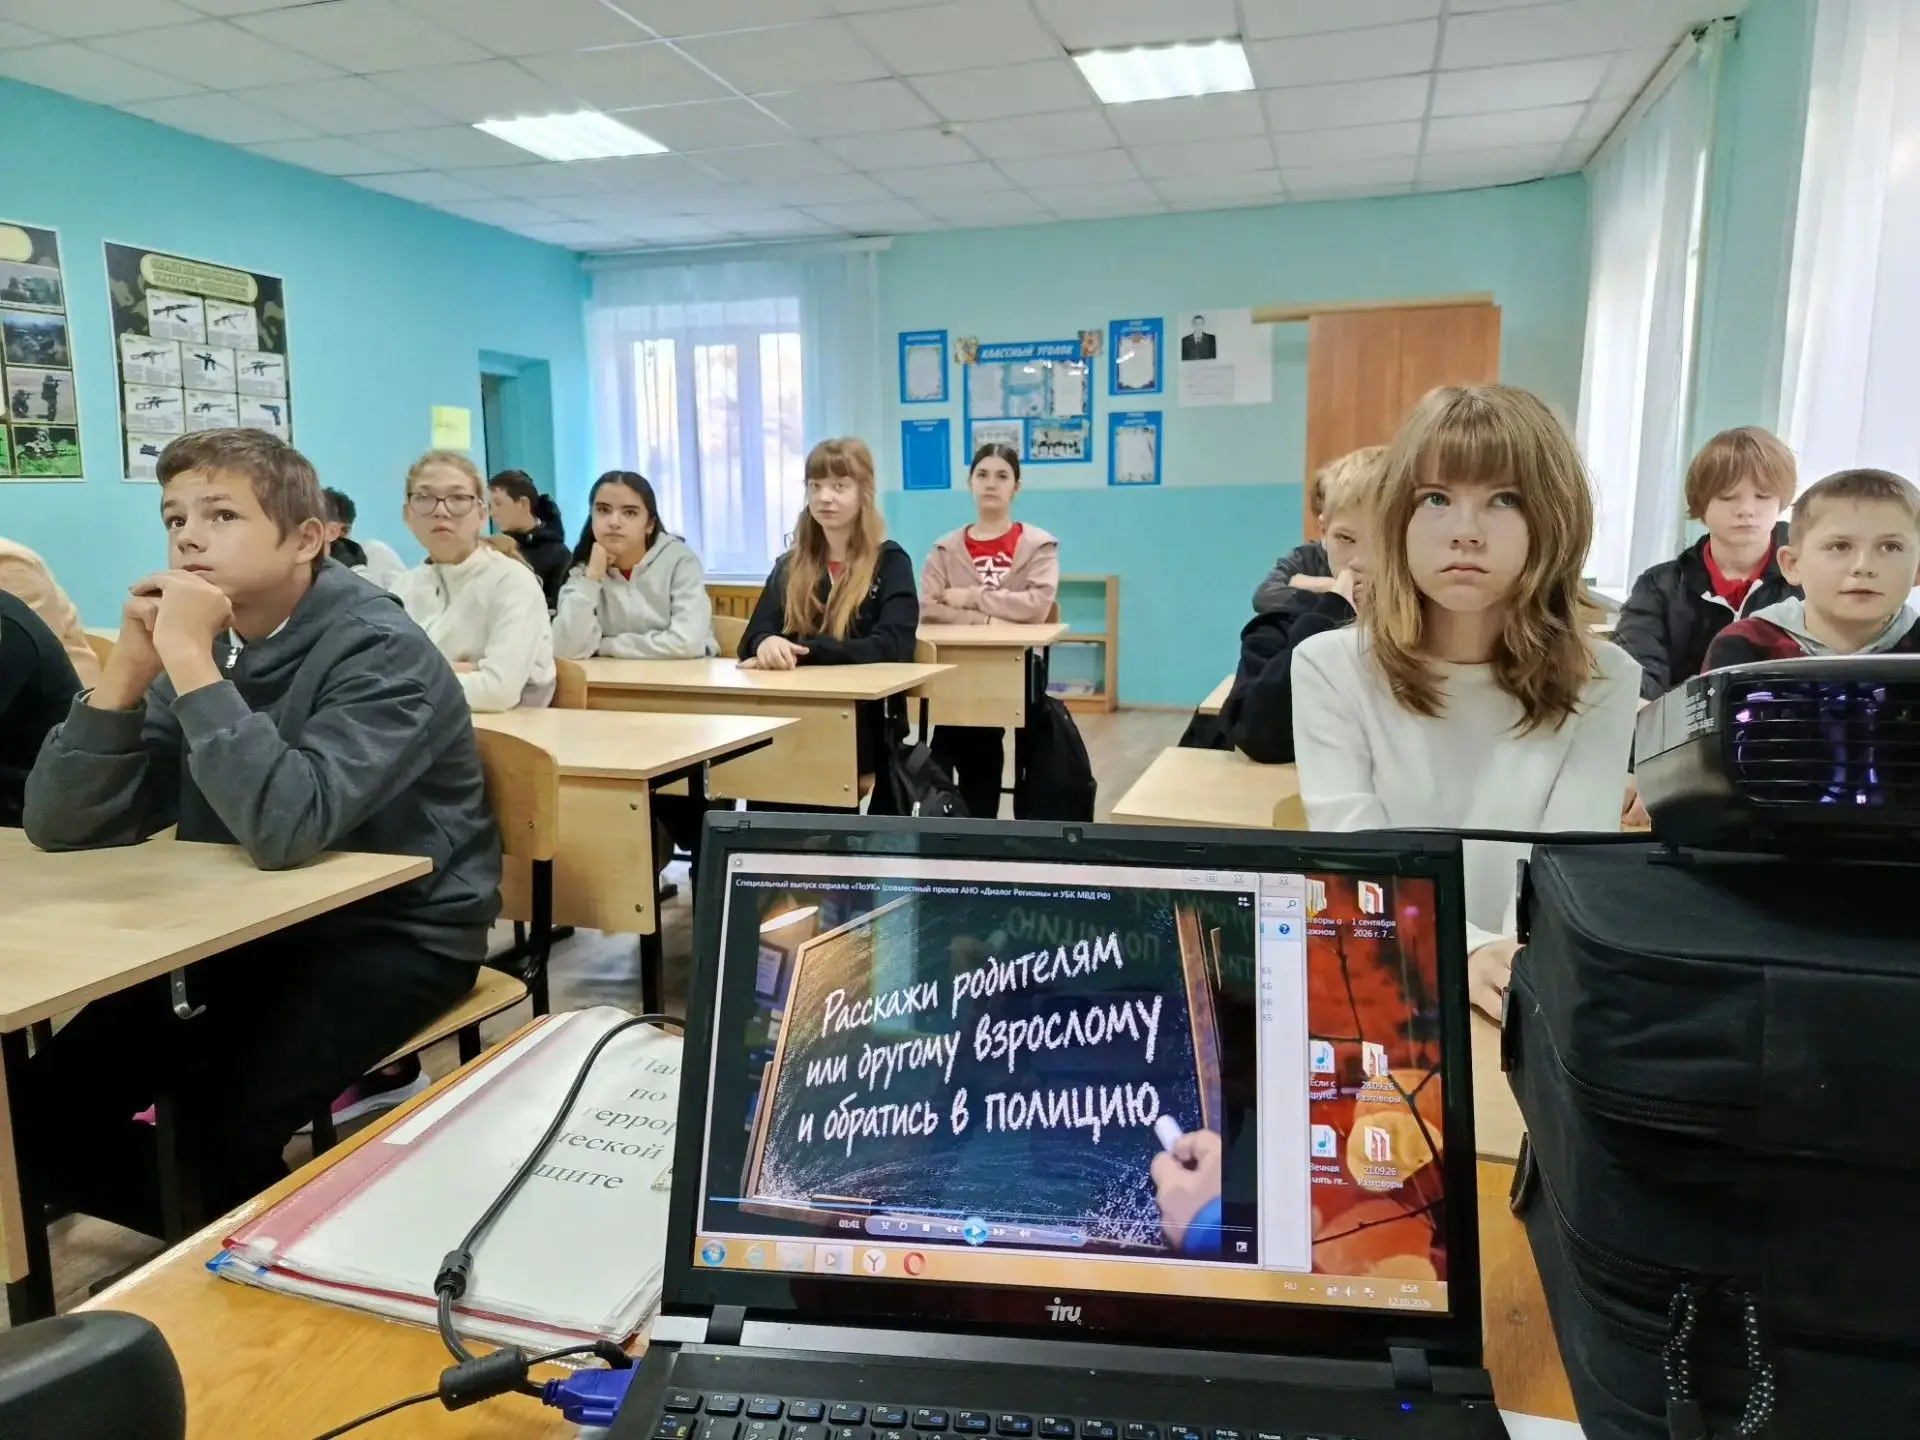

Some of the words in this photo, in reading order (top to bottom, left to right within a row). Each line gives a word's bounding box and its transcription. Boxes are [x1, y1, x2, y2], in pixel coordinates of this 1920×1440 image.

[735, 878, 789, 888] Специальный
[790, 881, 817, 890] выпуск
[818, 882, 850, 891] сериала
[882, 884, 931, 893] (совместный
[932, 886, 959, 895] проект
[960, 886, 979, 894] АНО
[980, 887, 1012, 896] «Диалог
[1060, 890, 1076, 899] УБК
[1077, 891, 1095, 900] МВД
[1097, 891, 1111, 901] РФ)
[1358, 918, 1396, 928] сентября
[821, 980, 939, 1039] Расскажи
[951, 931, 1123, 1020] родителям
[806, 1055, 848, 1088] или
[857, 1030, 961, 1091] другому
[973, 995, 1163, 1074] взрослому
[797, 1111, 814, 1144] и
[823, 1092, 940, 1158] обратись
[950, 1087, 970, 1136] в
[839, 1219, 860, 1230] 01:41
